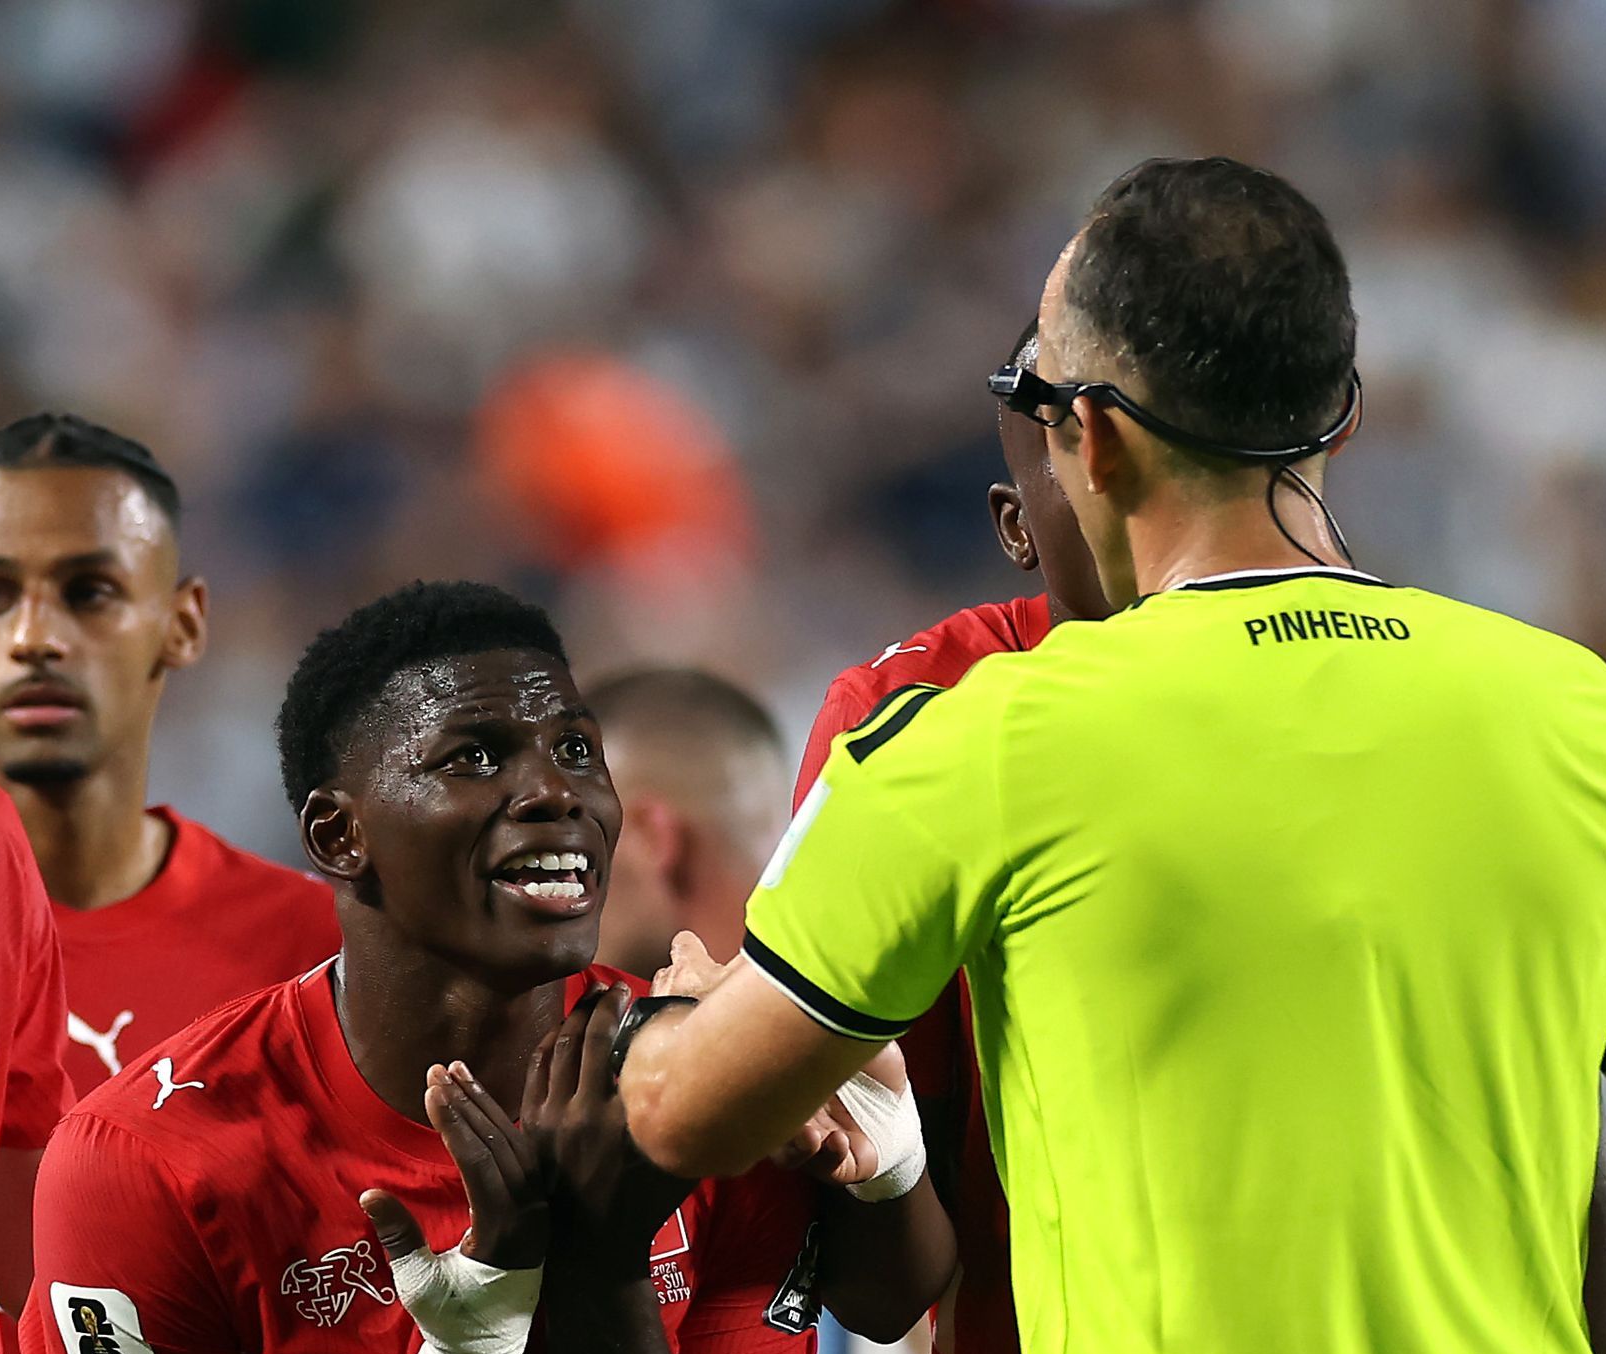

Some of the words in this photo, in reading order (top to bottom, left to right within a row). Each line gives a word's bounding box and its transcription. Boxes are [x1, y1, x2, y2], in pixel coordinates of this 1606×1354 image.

[1245, 610, 1410, 646] PINHEIRO
[662, 1271, 685, 1290] SUI
[666, 1286, 691, 1303] CITY
